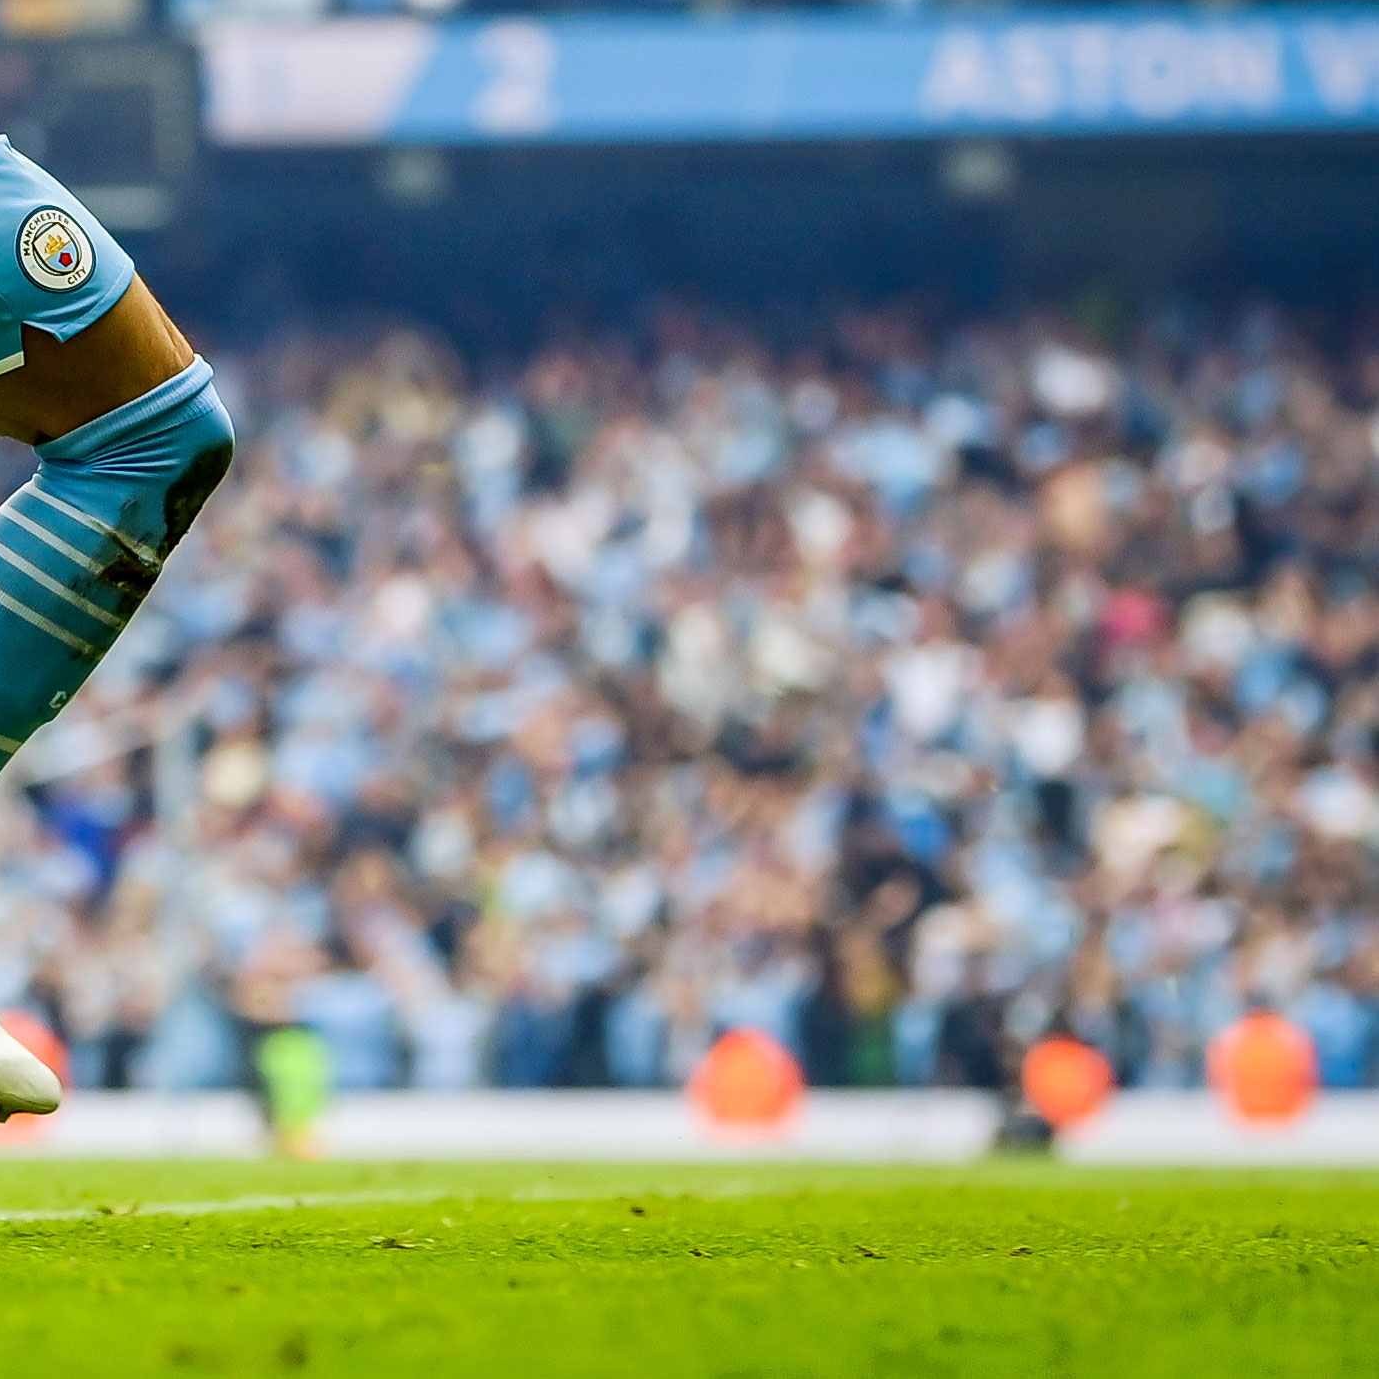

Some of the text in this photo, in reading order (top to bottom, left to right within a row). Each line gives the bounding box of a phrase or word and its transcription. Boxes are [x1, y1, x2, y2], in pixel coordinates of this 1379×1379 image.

[923, 24, 1283, 119] ASTON
[22, 212, 70, 257] MANCHESTER
[67, 265, 87, 285] CITY
